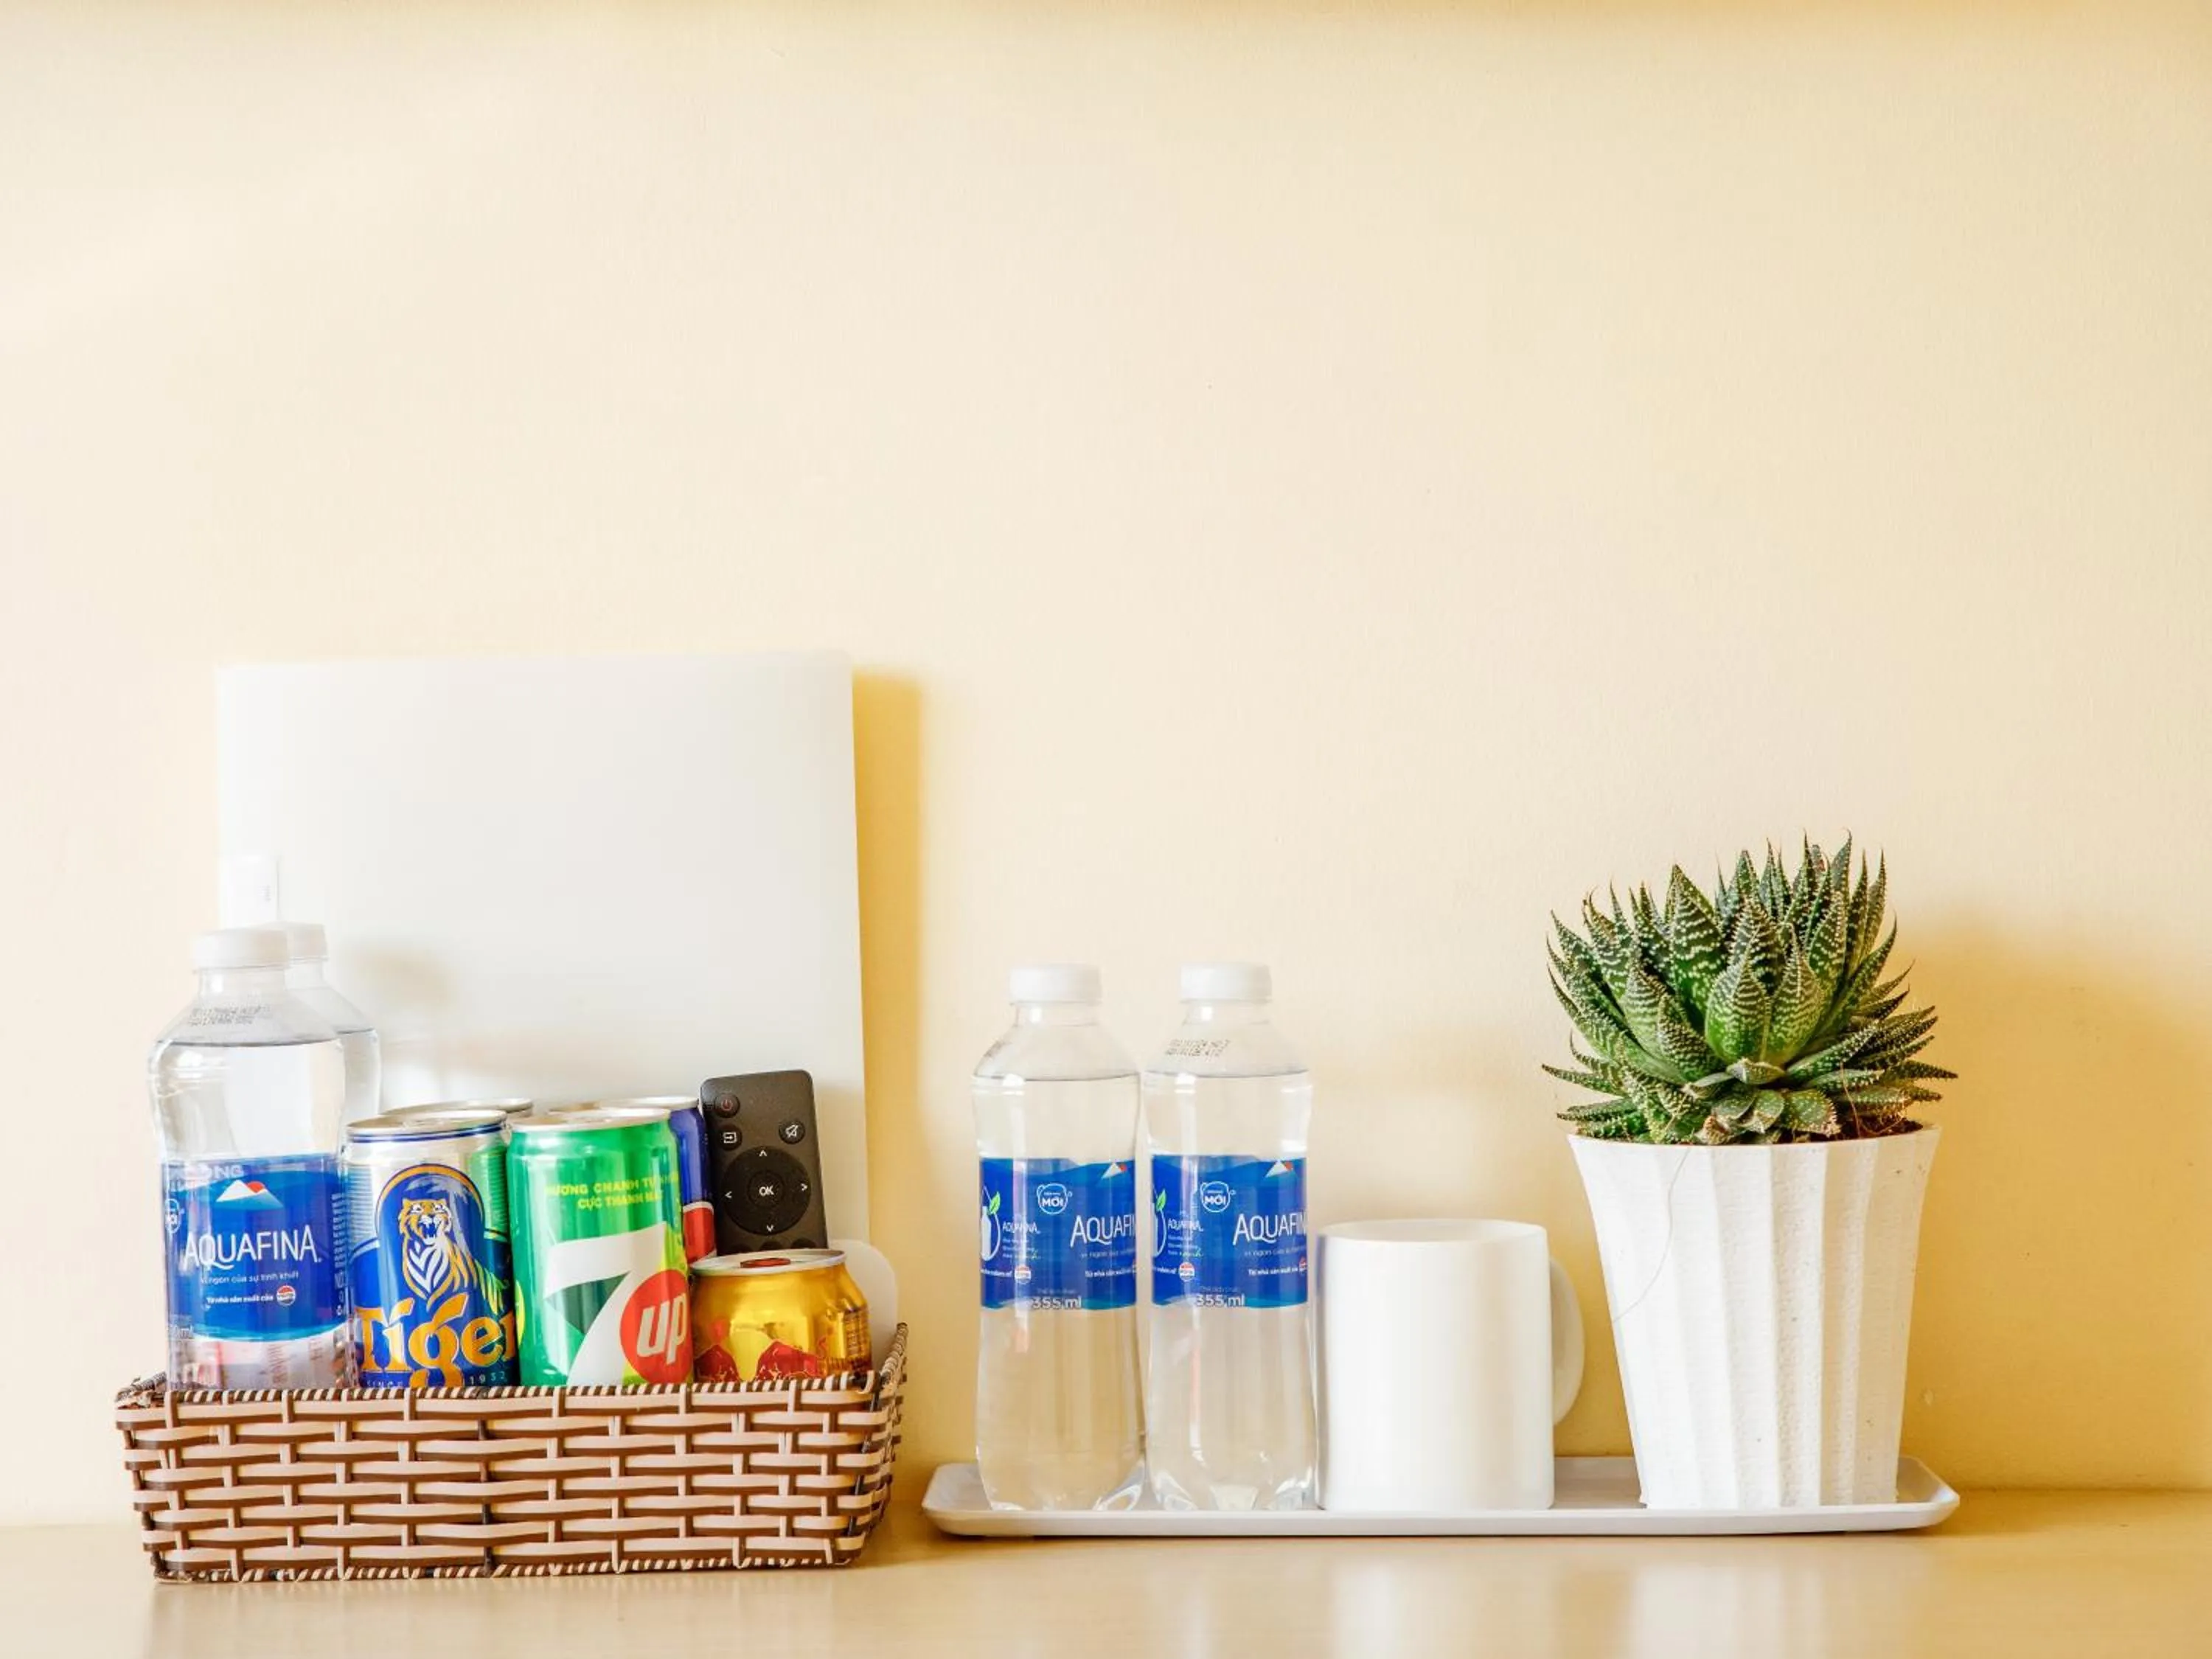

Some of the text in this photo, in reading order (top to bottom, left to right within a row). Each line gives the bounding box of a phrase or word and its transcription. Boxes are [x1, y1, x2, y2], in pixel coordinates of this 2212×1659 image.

[759, 1185, 775, 1197] OK
[183, 1224, 318, 1270] AQUAFINA
[1032, 1295, 1061, 1310] 355
[1196, 1293, 1245, 1307] 355 ml
